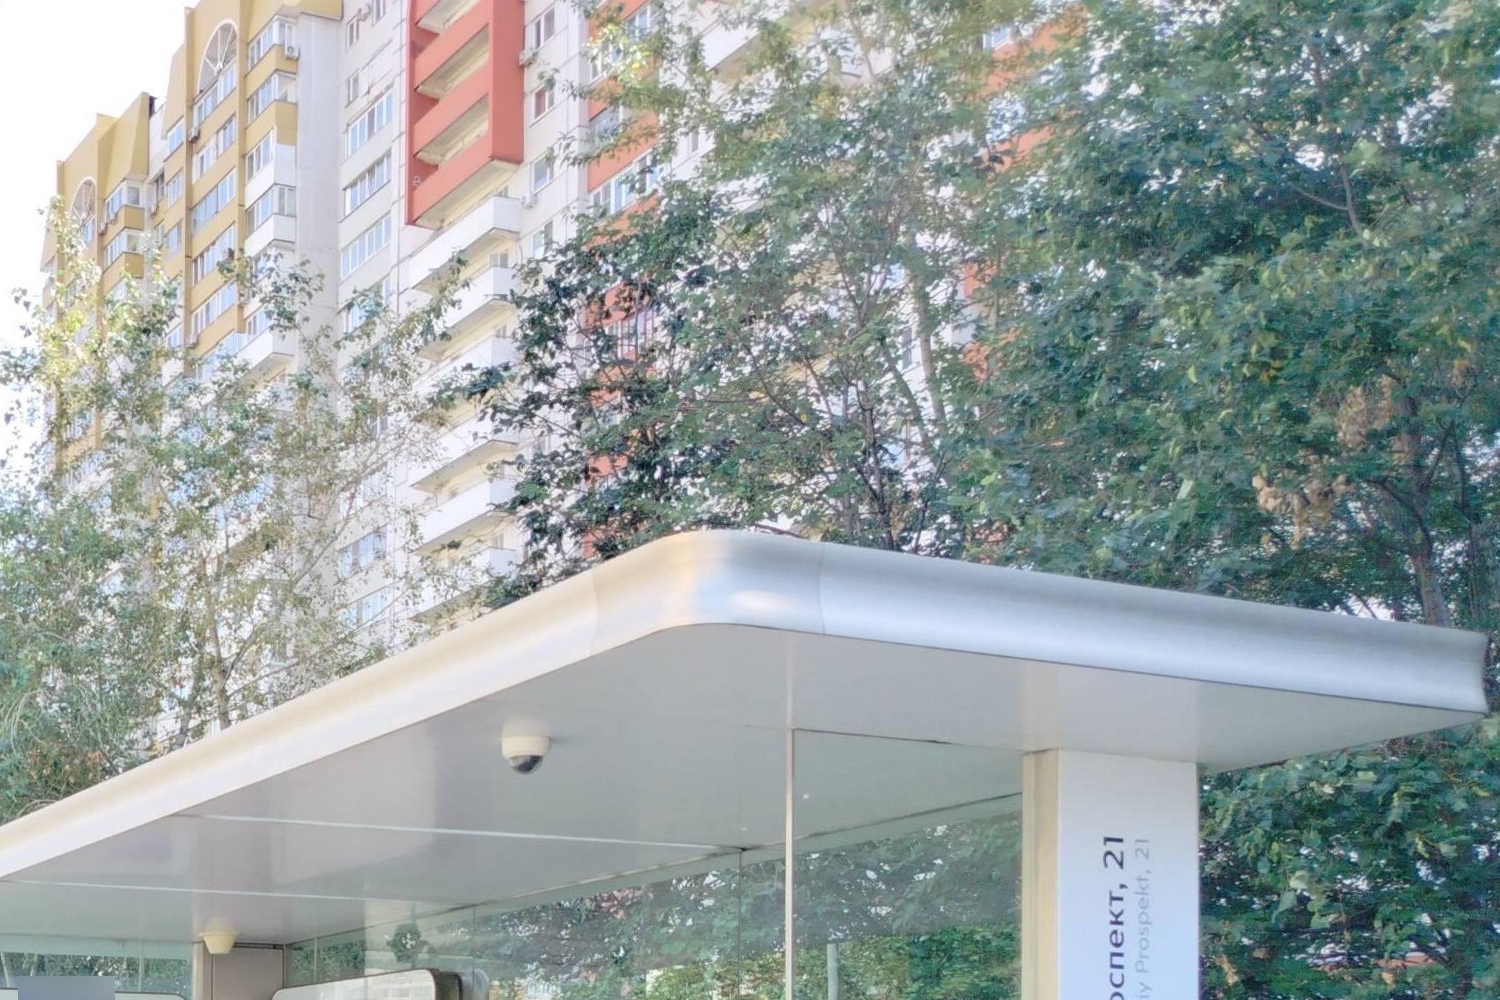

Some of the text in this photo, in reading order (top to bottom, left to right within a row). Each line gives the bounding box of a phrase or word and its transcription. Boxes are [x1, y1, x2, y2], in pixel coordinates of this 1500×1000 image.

[1102, 836, 1125, 870] 21
[1134, 838, 1149, 860] 21
[1134, 869, 1153, 974] Prospekt,
